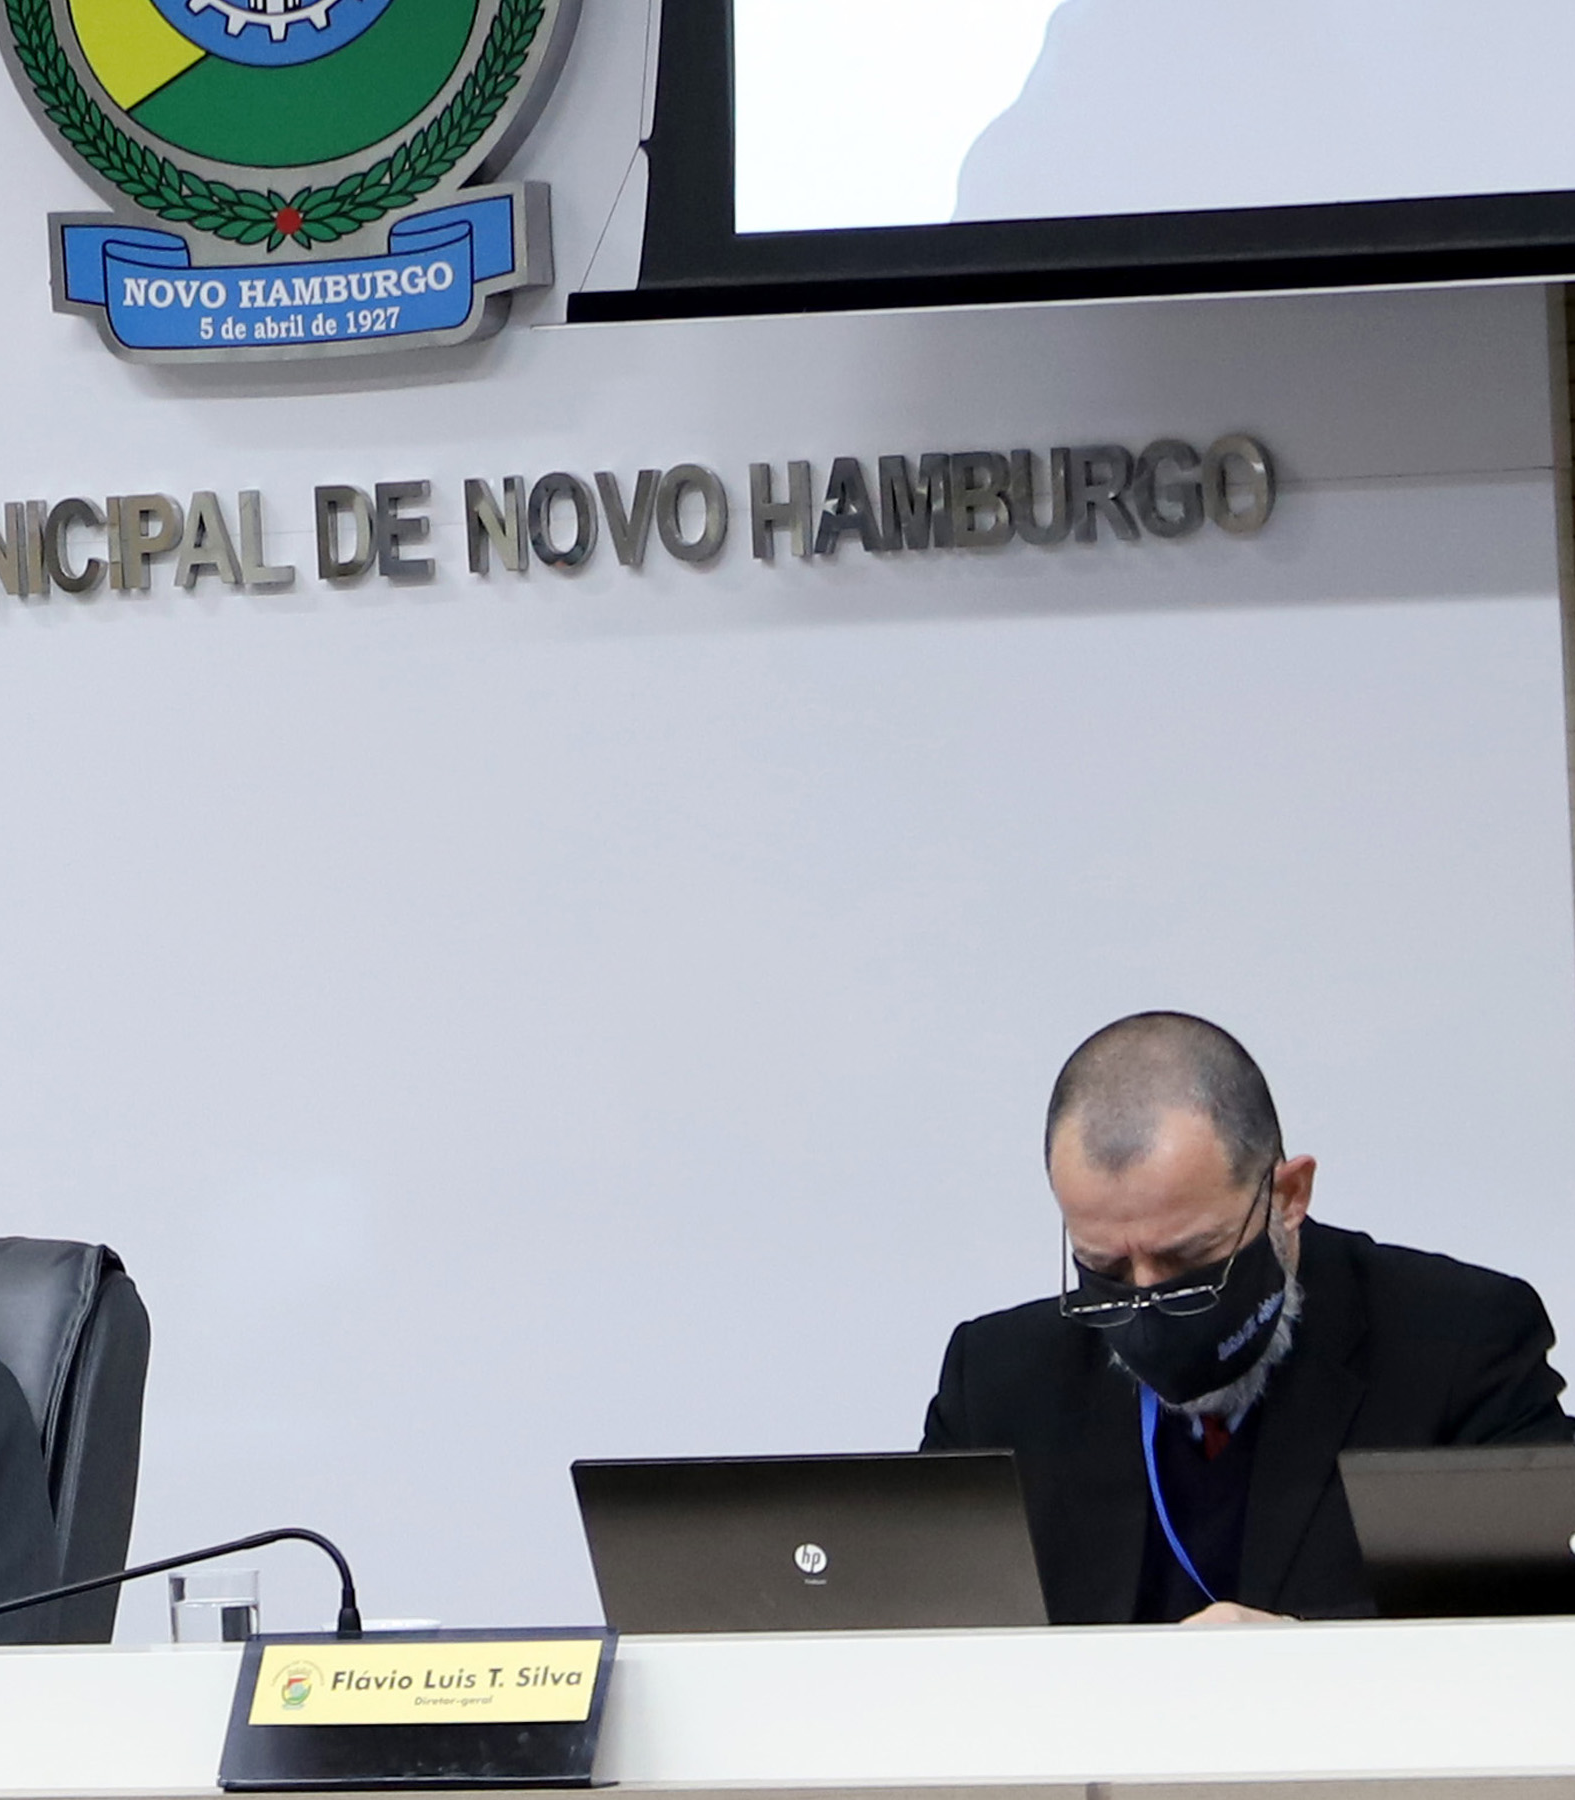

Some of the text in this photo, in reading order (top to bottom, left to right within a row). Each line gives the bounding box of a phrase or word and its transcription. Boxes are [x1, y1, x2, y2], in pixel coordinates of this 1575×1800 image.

[122, 261, 454, 309] NOVO HAMBURGO
[199, 306, 401, 340] 5 de abril de 1927
[314, 479, 436, 581] DE
[463, 463, 729, 574] NOVO
[750, 432, 1277, 560] HAMBURGO
[331, 1669, 413, 1691] Flávio
[423, 1668, 477, 1690] Luis
[489, 1668, 505, 1689] T.
[515, 1665, 583, 1688] Silva
